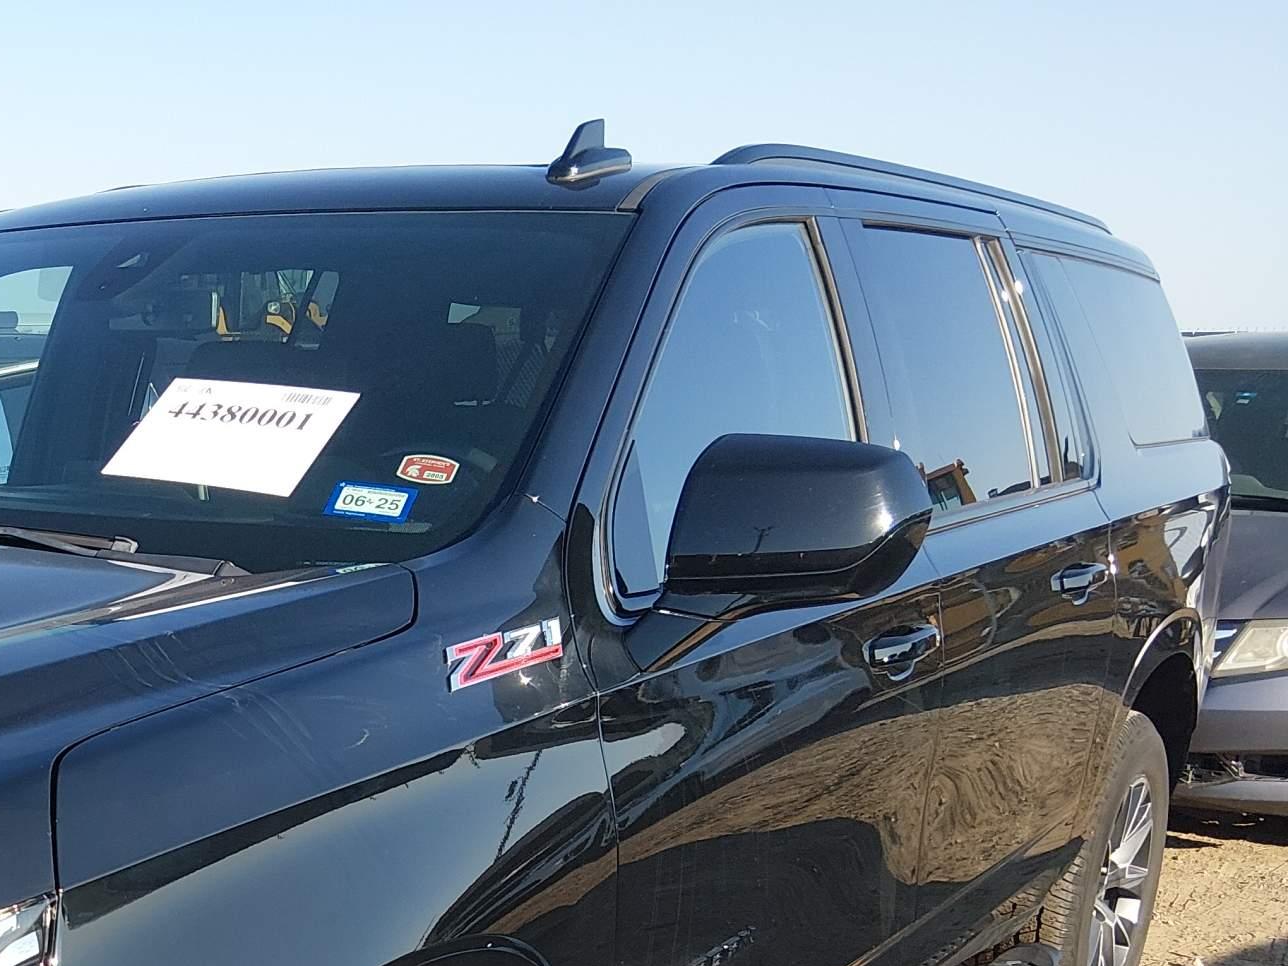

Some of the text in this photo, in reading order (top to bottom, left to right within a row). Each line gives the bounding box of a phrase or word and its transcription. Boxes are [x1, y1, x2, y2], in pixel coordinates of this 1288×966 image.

[168, 401, 314, 431] 44380001
[342, 494, 367, 507] 06
[375, 497, 402, 511] 25
[442, 615, 563, 693] Z71
